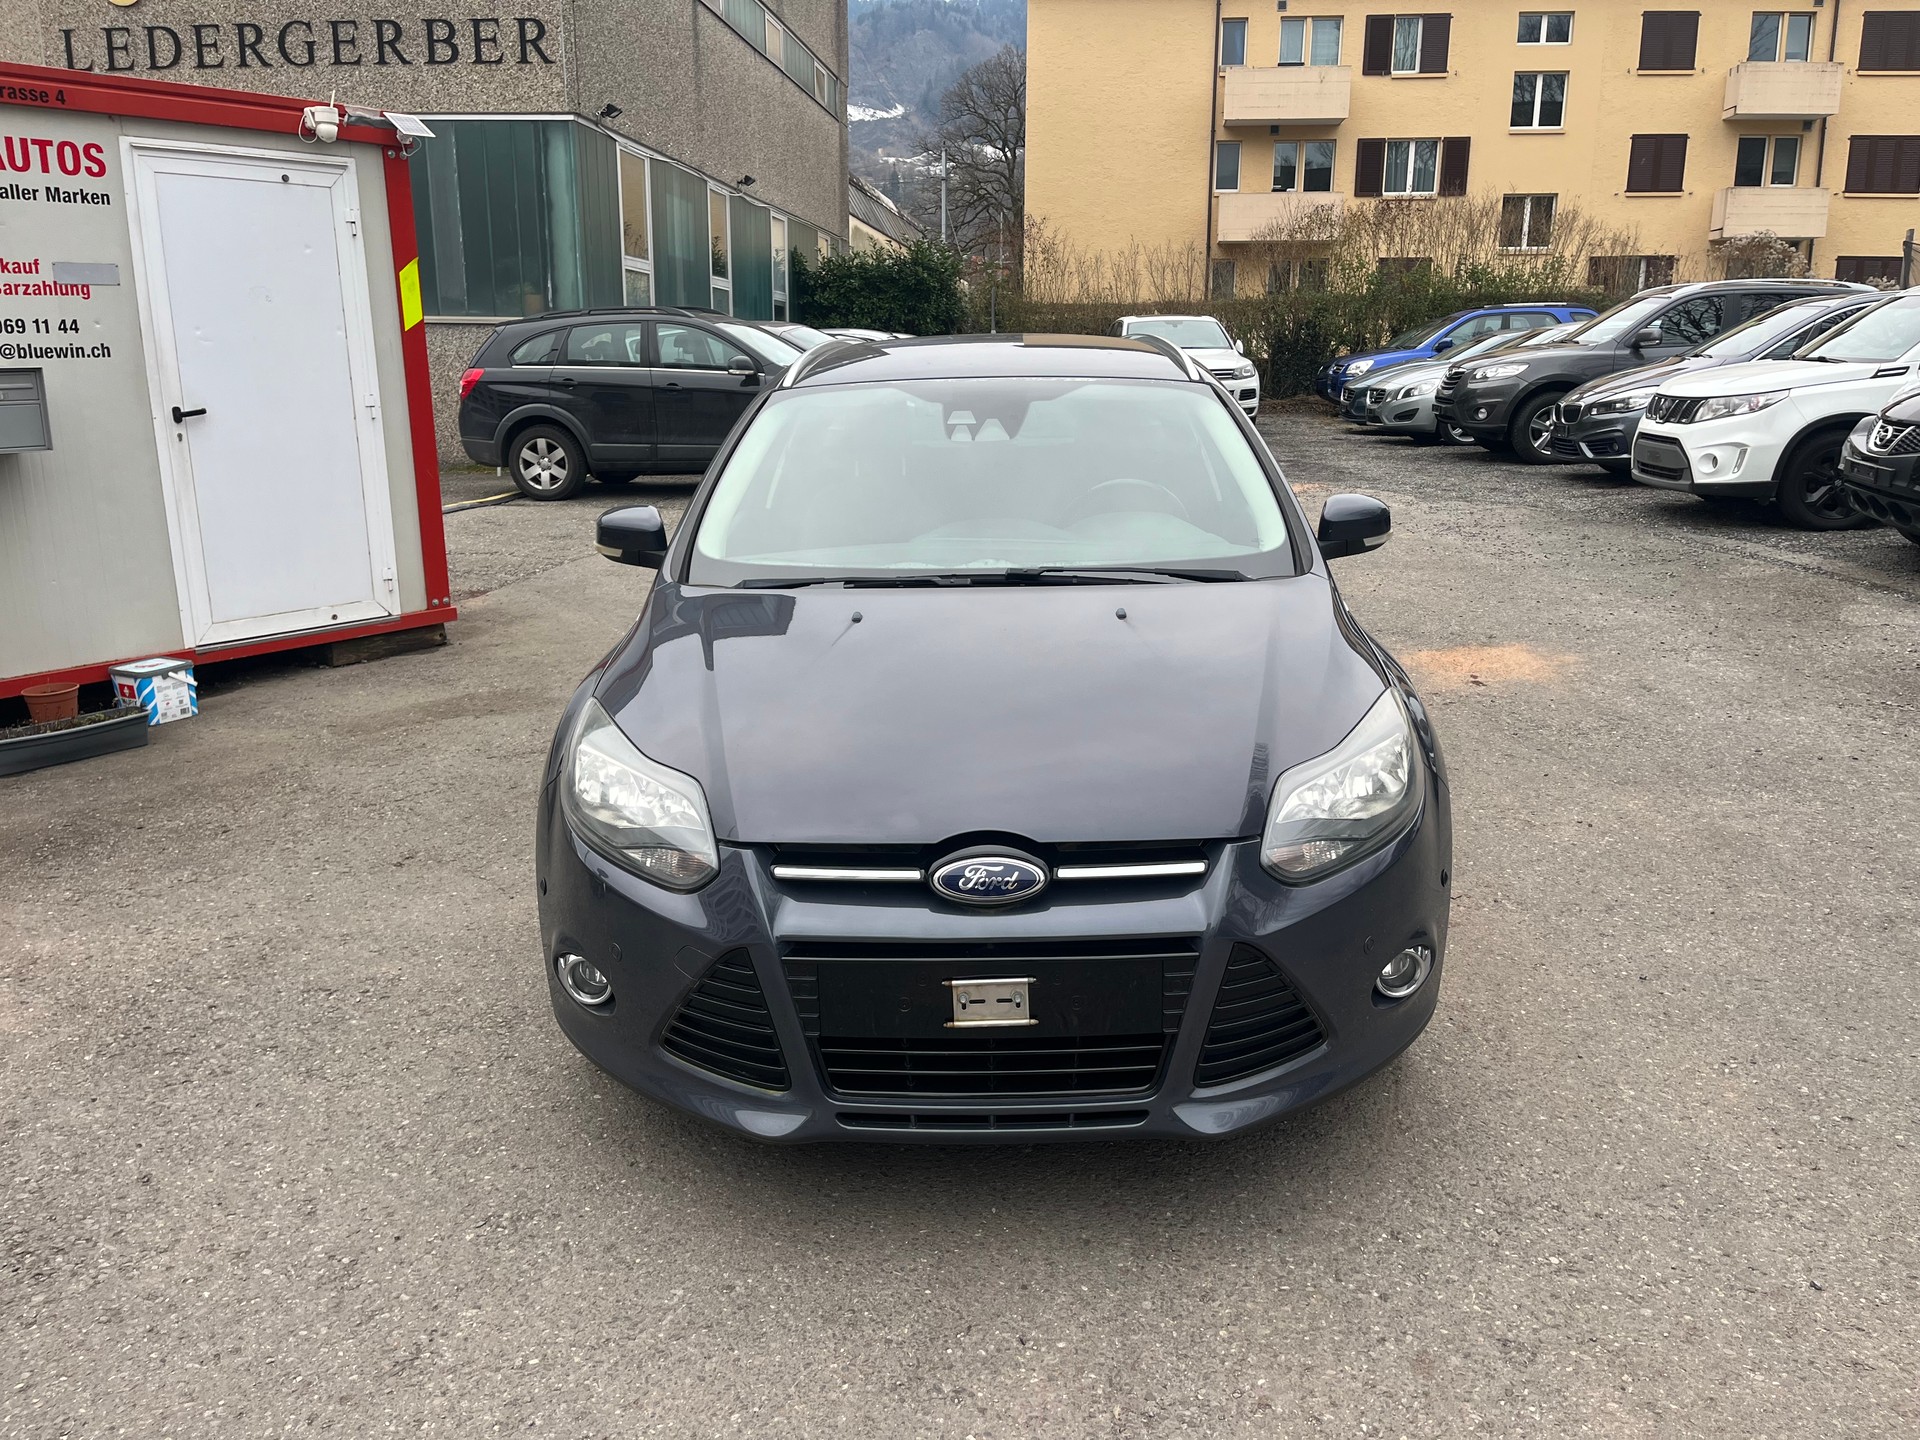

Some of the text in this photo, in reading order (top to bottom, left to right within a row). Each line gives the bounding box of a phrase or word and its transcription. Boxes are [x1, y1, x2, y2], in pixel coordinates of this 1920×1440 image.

[61, 17, 556, 72] LEDERGERBER
[55, 89, 66, 105] 4
[0, 183, 111, 205] aller Marken
[0, 280, 91, 300] arzahlung
[0, 318, 80, 334] 69 11 44
[0, 343, 112, 360] @bluewin.ch
[958, 865, 1019, 891] Ford
